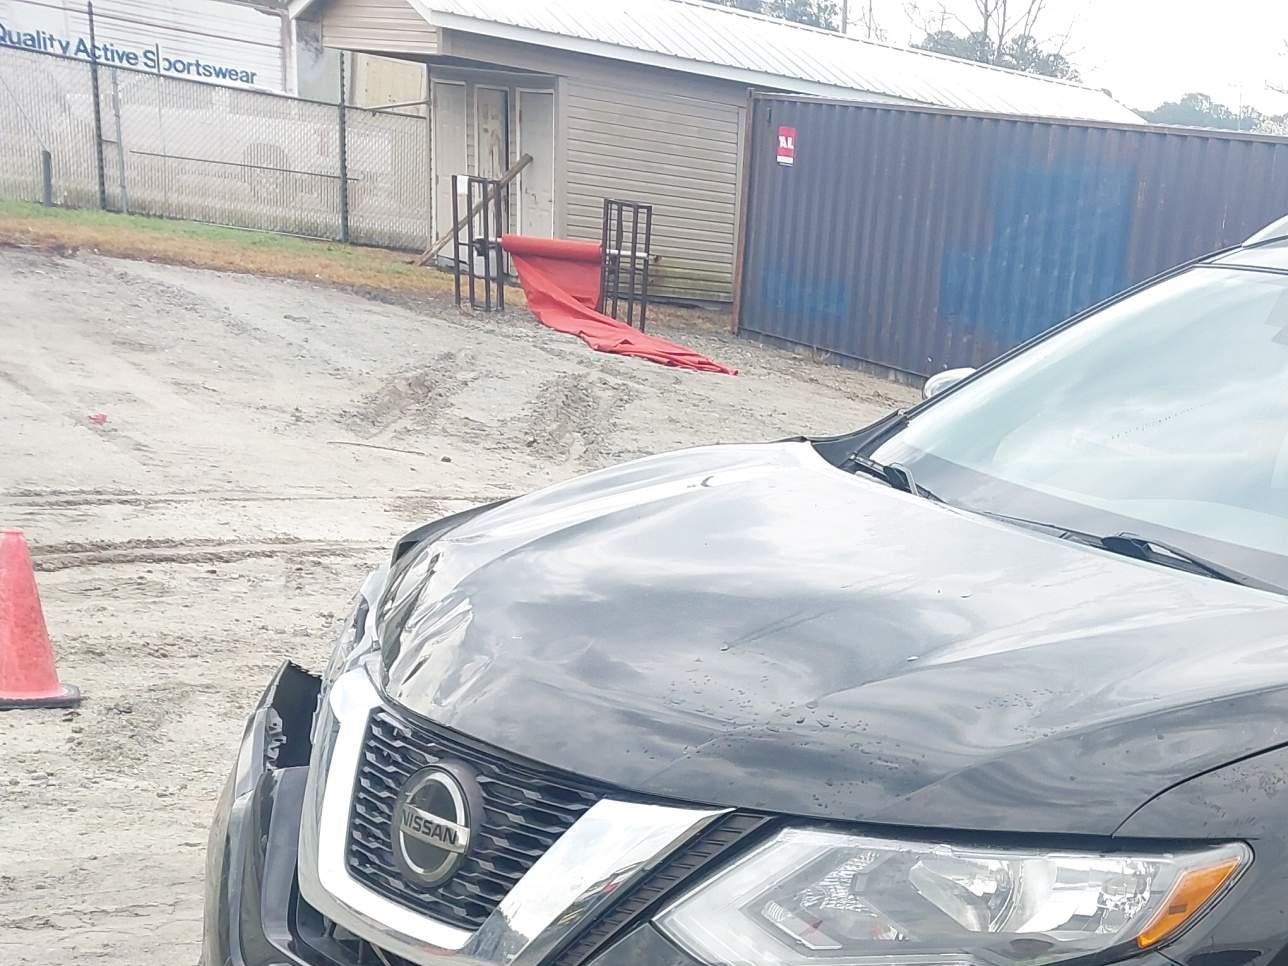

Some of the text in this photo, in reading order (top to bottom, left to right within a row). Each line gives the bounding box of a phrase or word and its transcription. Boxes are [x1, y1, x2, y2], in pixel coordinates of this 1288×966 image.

[74, 37, 138, 65] Active
[143, 50, 257, 84] Sportswear
[401, 808, 458, 846] NISSAN
